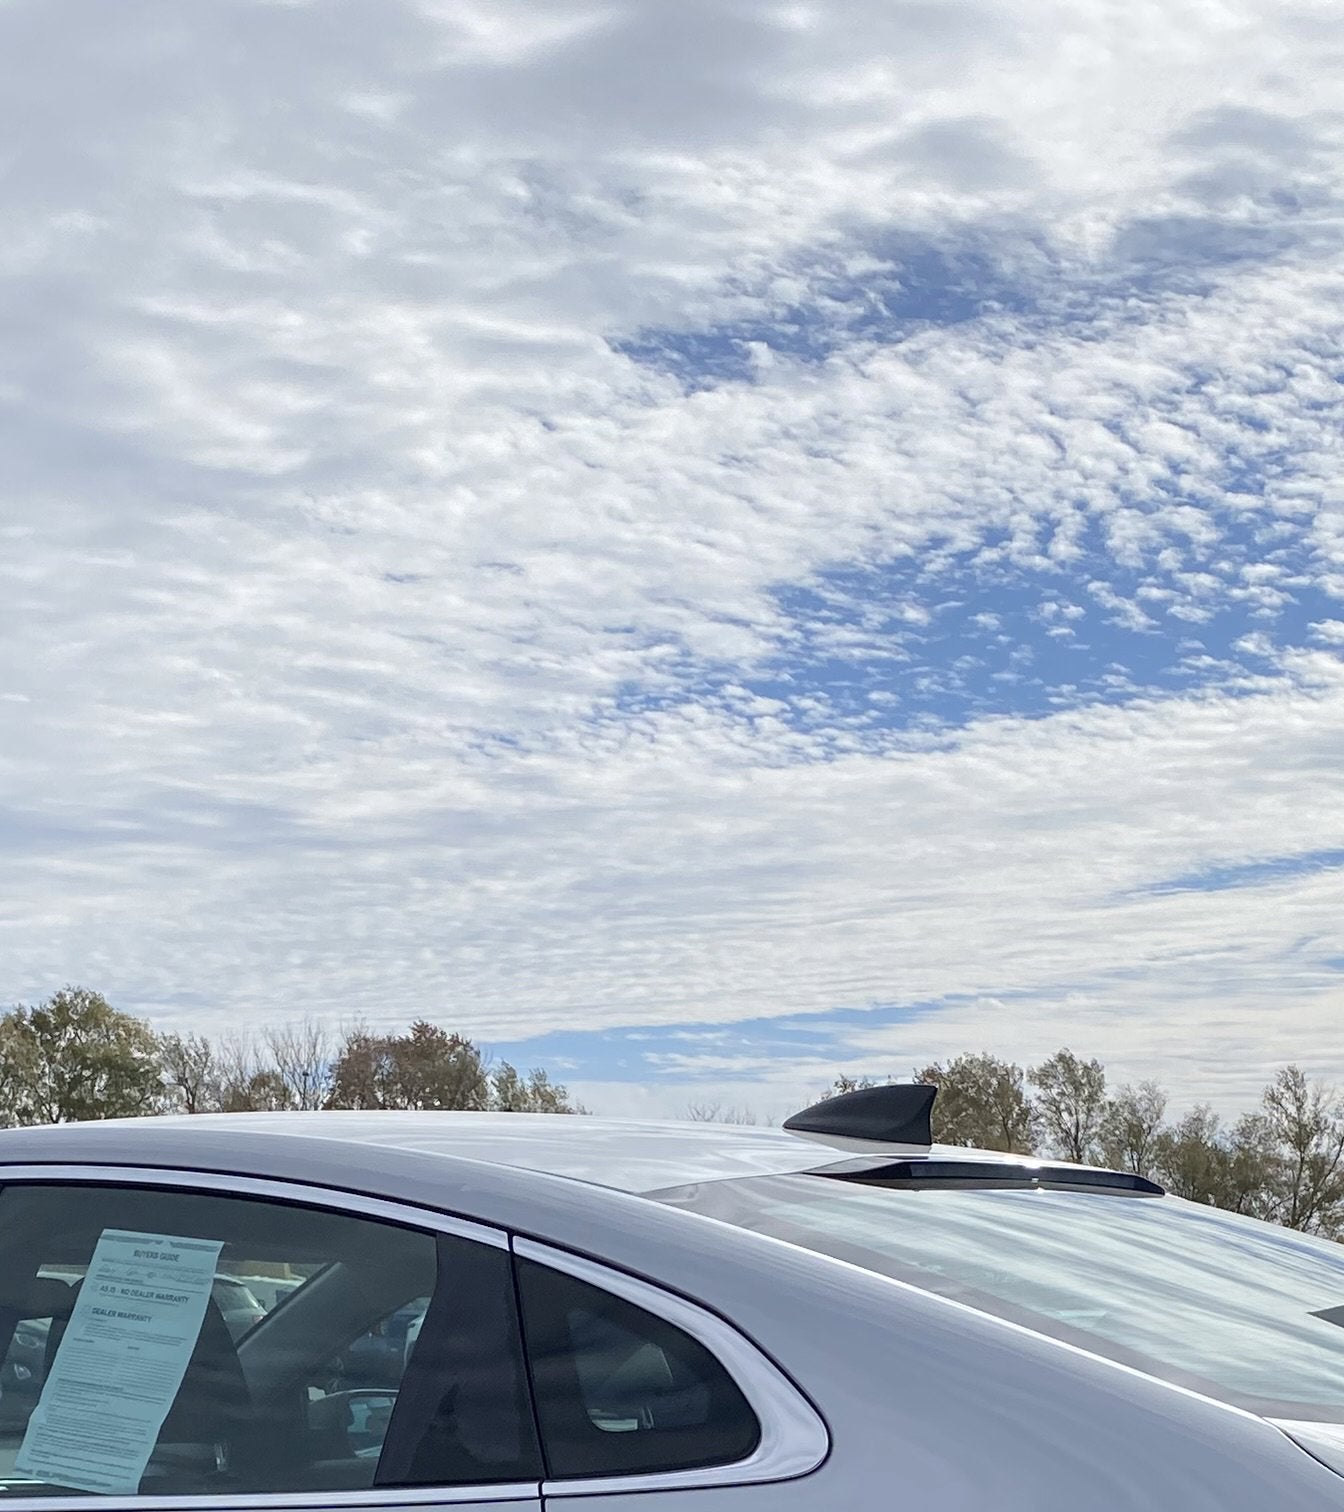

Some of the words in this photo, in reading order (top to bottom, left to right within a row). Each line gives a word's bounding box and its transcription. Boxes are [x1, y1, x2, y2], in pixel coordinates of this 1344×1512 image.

[129, 1289, 155, 1299] DEALER
[155, 1293, 191, 1304] WARRANTY
[91, 1307, 117, 1318] DEALER
[117, 1311, 153, 1323] WARRANTY
